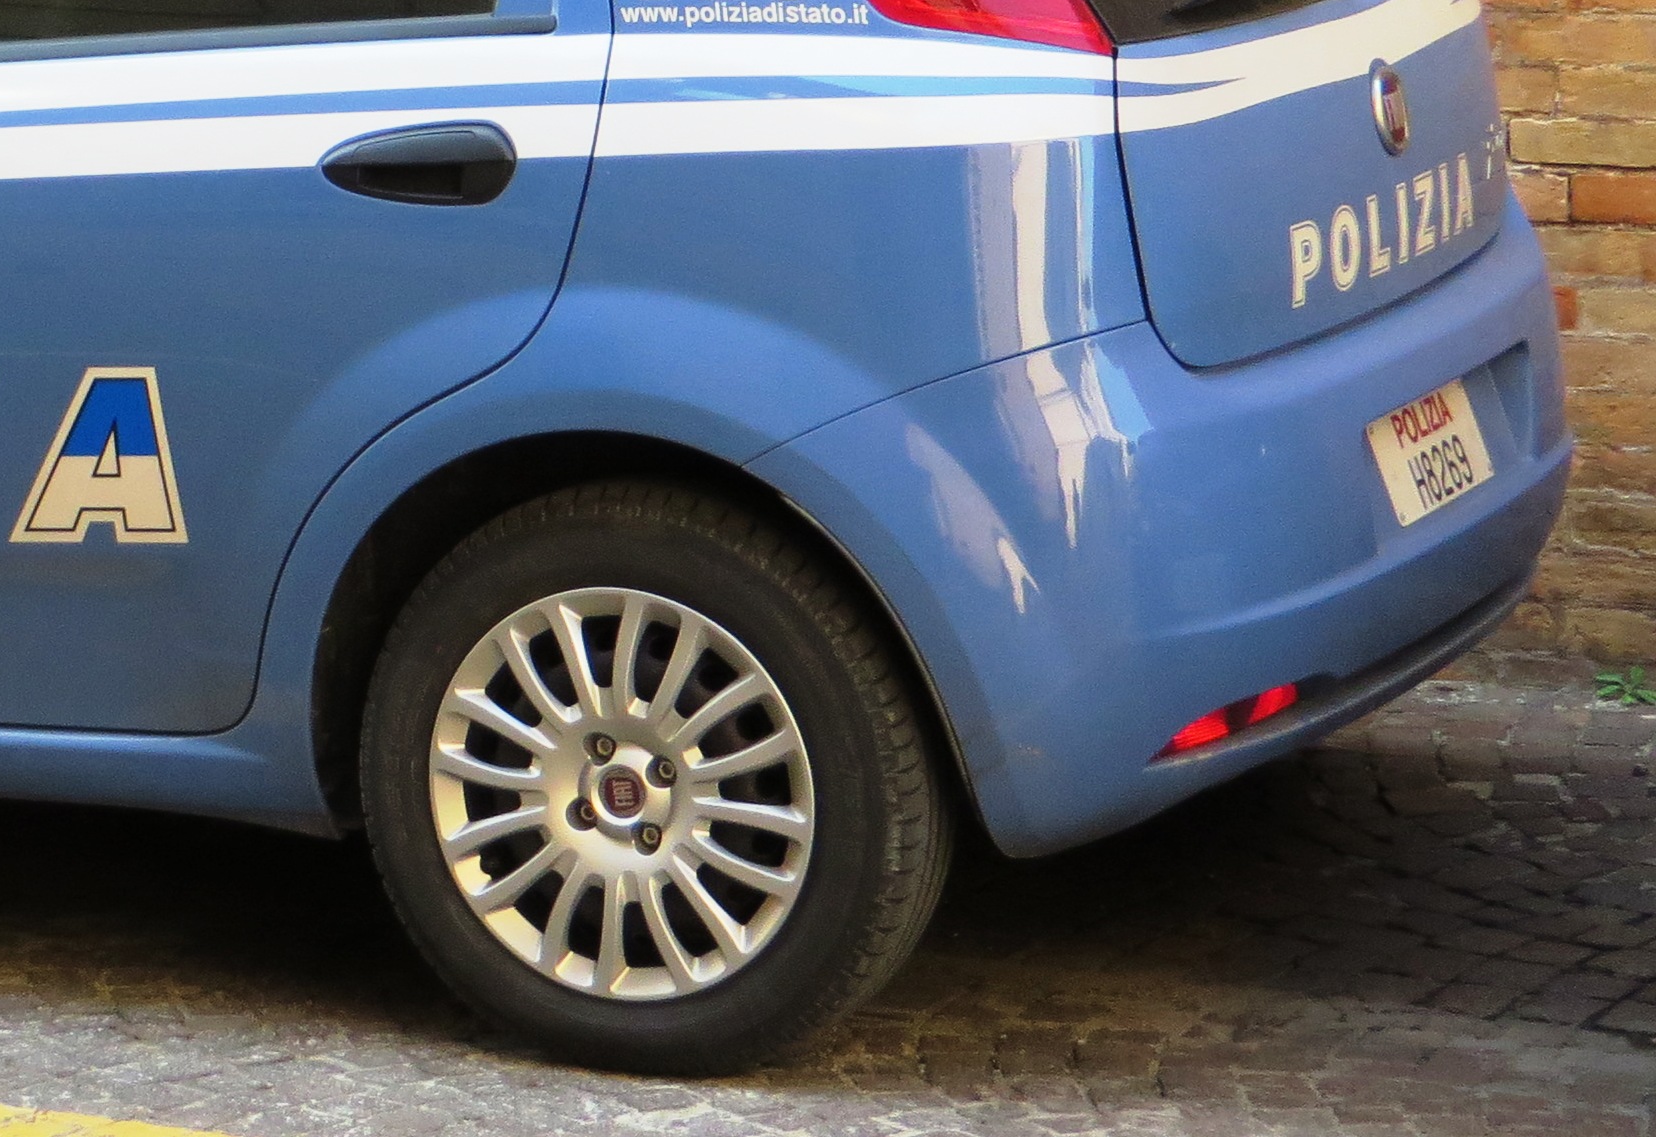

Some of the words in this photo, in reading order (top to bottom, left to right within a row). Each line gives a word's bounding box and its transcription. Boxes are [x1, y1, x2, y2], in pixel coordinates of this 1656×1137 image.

[620, 1, 869, 28] www.poliziadistato.it
[1289, 152, 1474, 309] POLIZIA
[1390, 391, 1454, 449] POLIZIA
[1407, 434, 1475, 511] H8269
